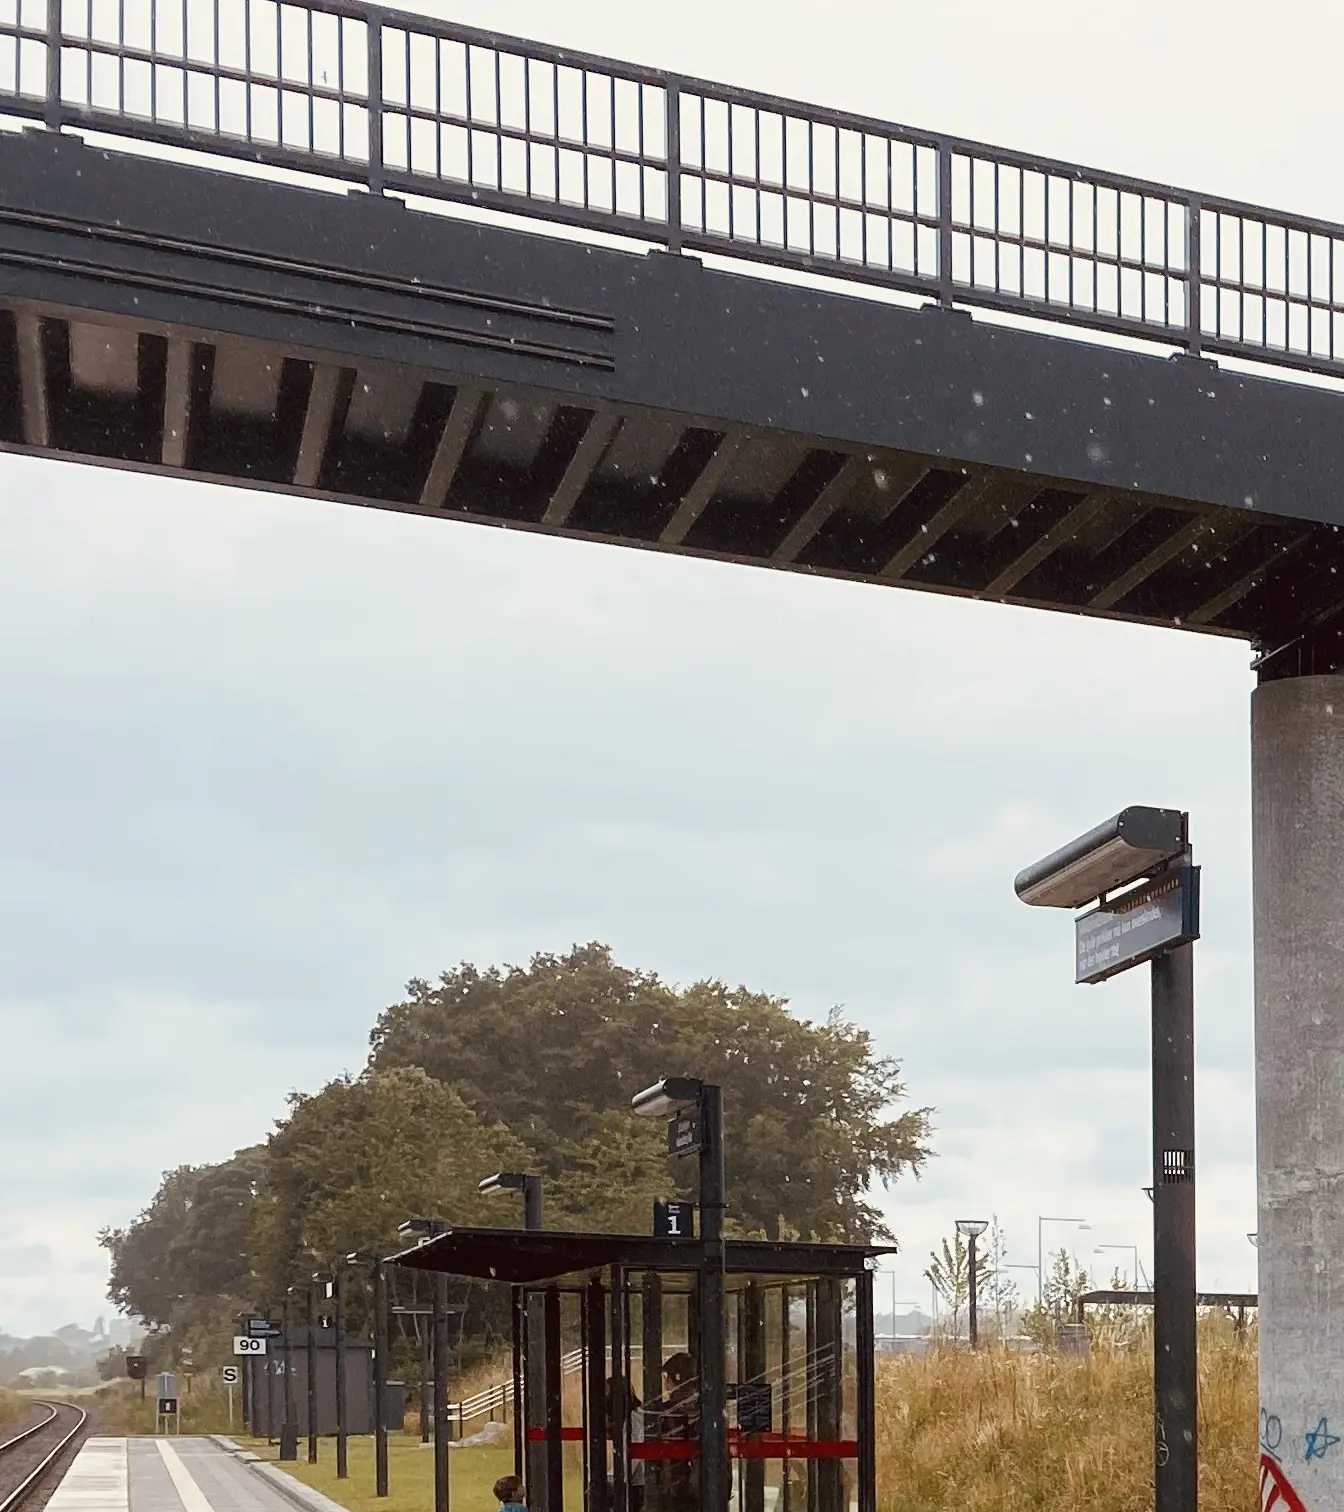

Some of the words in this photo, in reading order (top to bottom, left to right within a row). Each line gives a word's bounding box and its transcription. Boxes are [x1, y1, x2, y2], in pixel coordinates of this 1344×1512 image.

[668, 1215, 681, 1235] 1
[239, 1340, 260, 1351] 90
[224, 1368, 237, 1382] S
